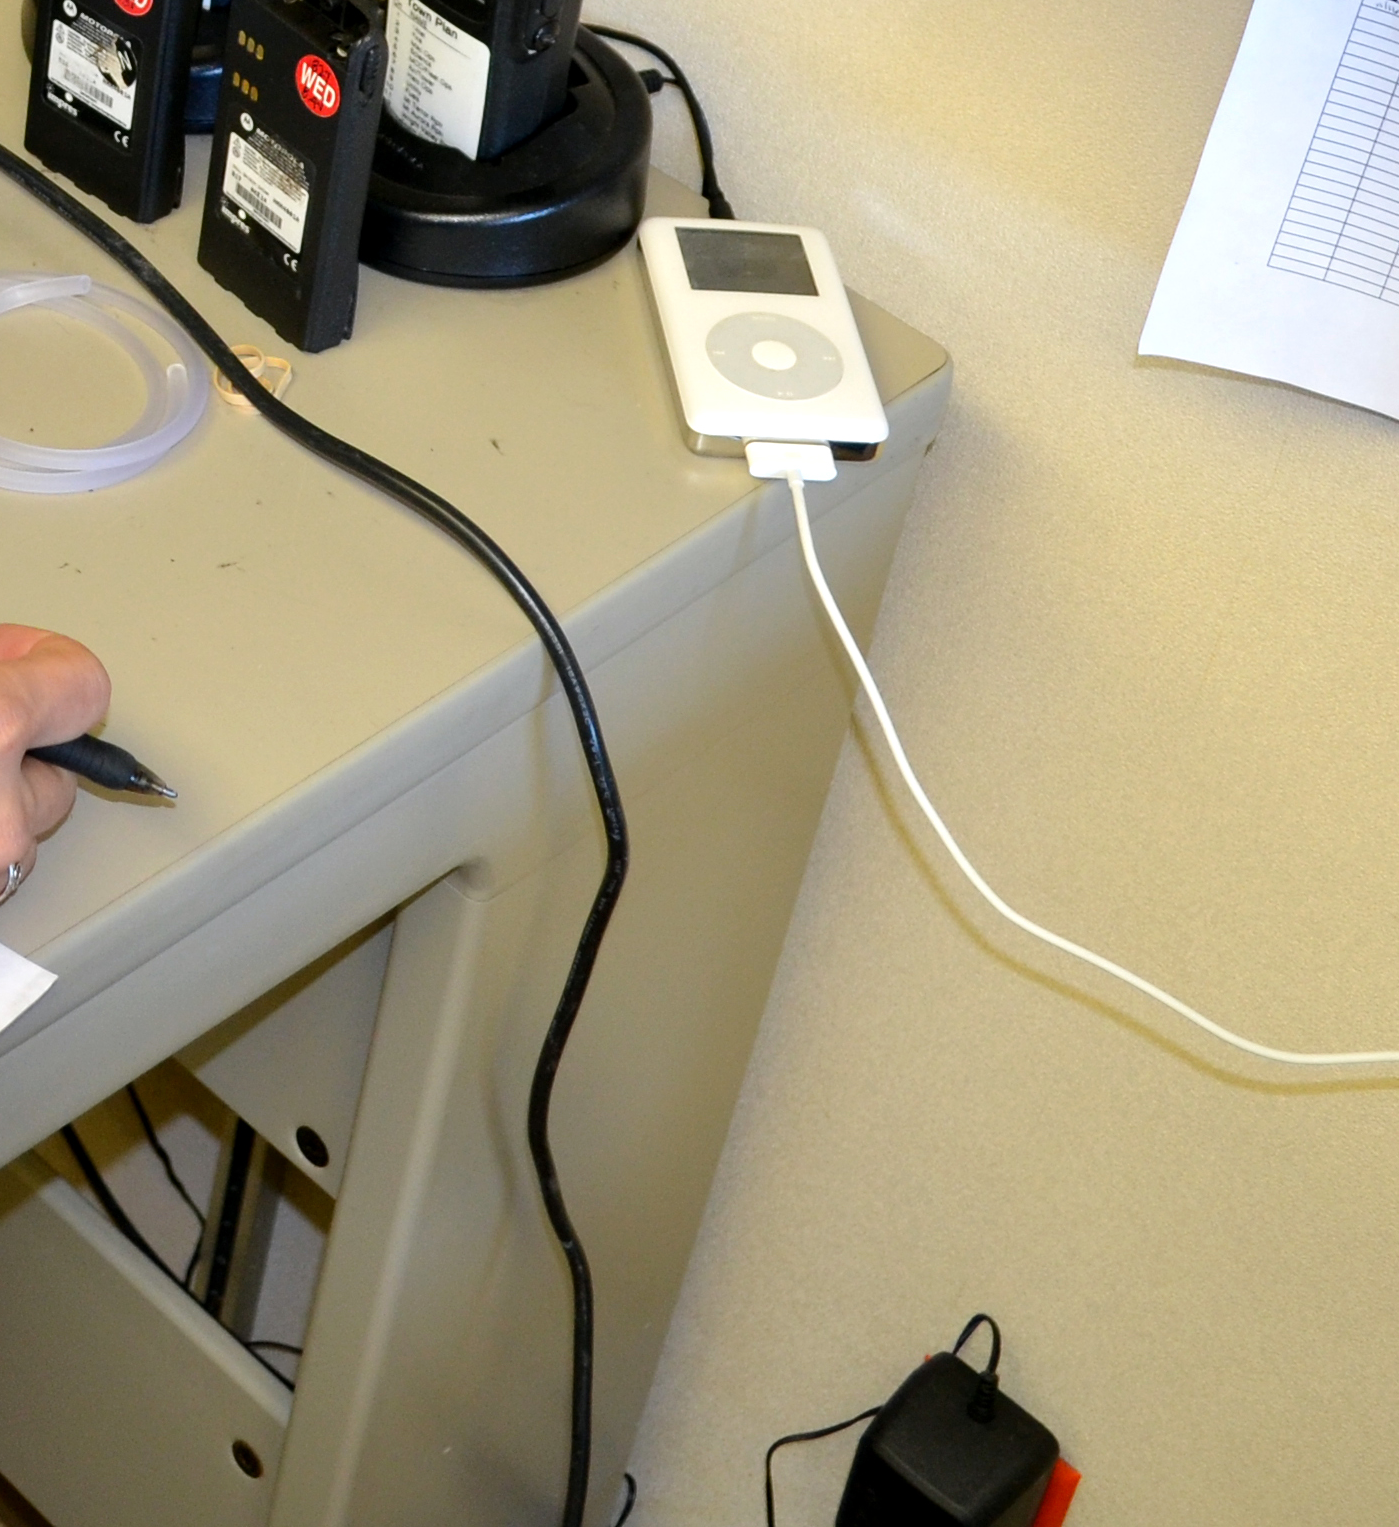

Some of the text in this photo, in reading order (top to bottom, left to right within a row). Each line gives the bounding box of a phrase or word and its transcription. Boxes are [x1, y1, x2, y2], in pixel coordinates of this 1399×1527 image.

[435, 17, 459, 41] Plan
[300, 62, 337, 110] WED
[255, 127, 306, 171] MOTOROLA
